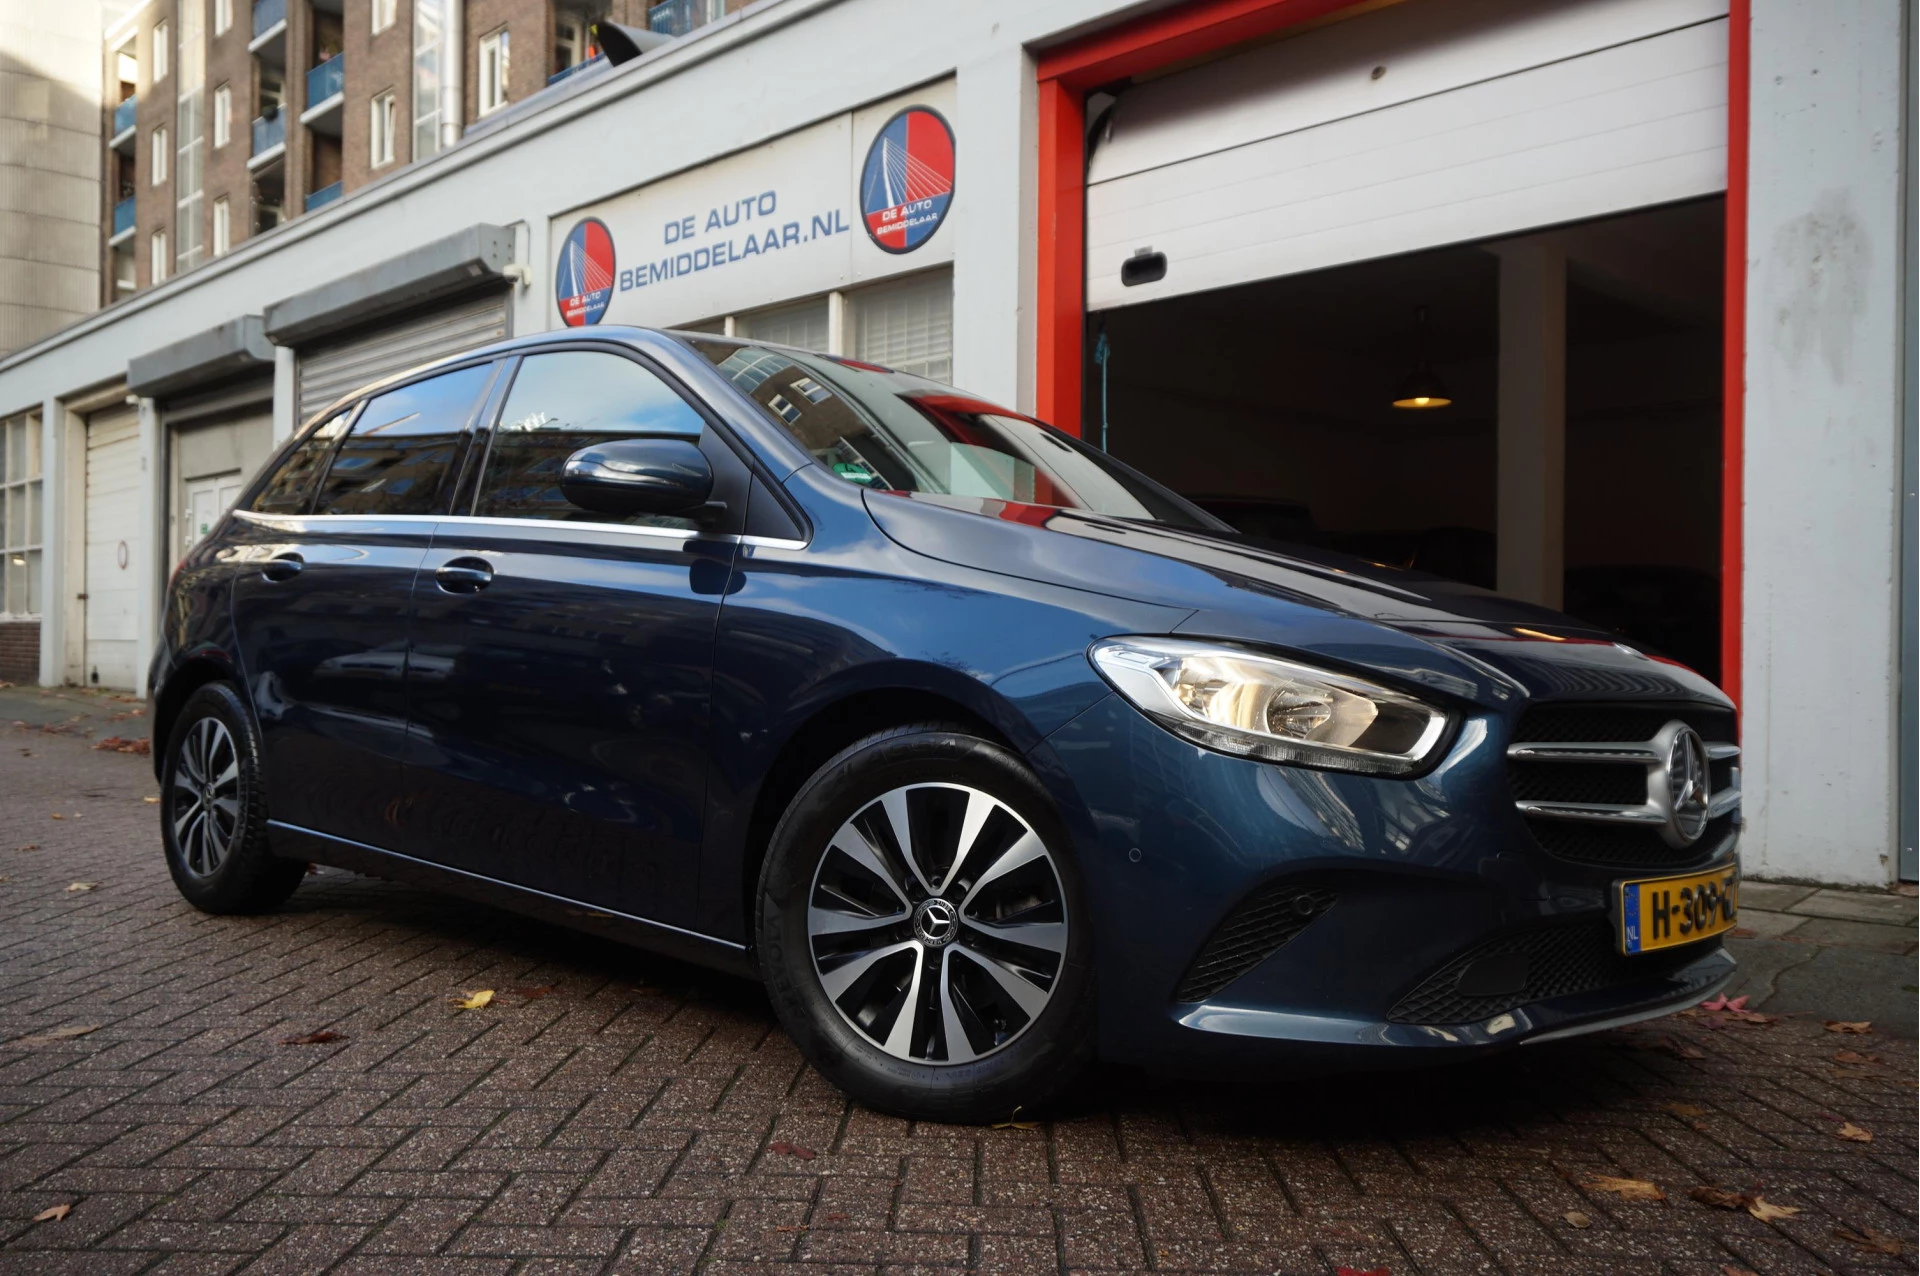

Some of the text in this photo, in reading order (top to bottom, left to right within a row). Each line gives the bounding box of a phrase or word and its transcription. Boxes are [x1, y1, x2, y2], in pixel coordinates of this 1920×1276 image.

[664, 190, 777, 245] DE AUTO
[882, 199, 932, 221] DE AUTO
[876, 211, 938, 235] BEMIDDELAAR
[619, 209, 850, 292] BEMIDDELAAR.NL
[570, 290, 601, 307] DE AUTO
[1626, 925, 1639, 941] NL
